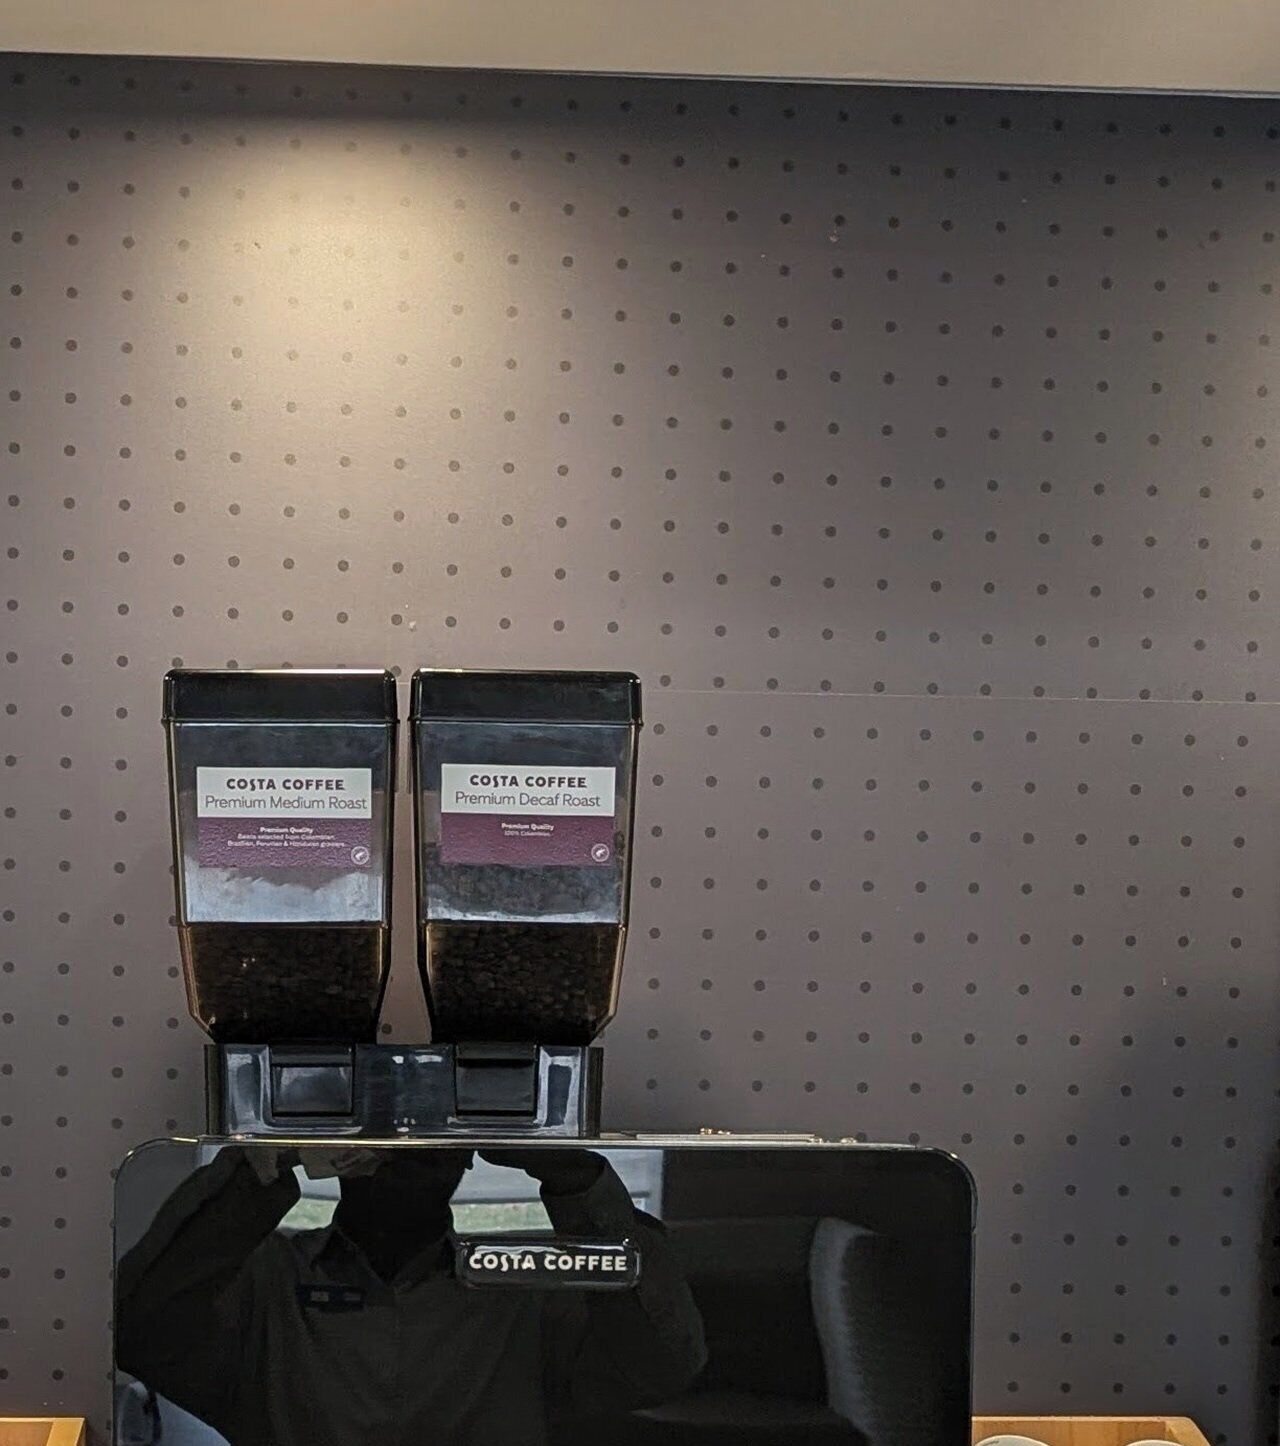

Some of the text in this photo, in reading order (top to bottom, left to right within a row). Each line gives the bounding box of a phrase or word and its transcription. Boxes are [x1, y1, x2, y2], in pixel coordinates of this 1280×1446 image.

[226, 778, 345, 791] COSTA COFFEE
[469, 774, 587, 788] COSTA COFFEE
[205, 795, 368, 810] Premium Medium Roast
[455, 791, 600, 807] Premium Decaf Roast
[469, 1254, 627, 1272] COSTA COFFEE
